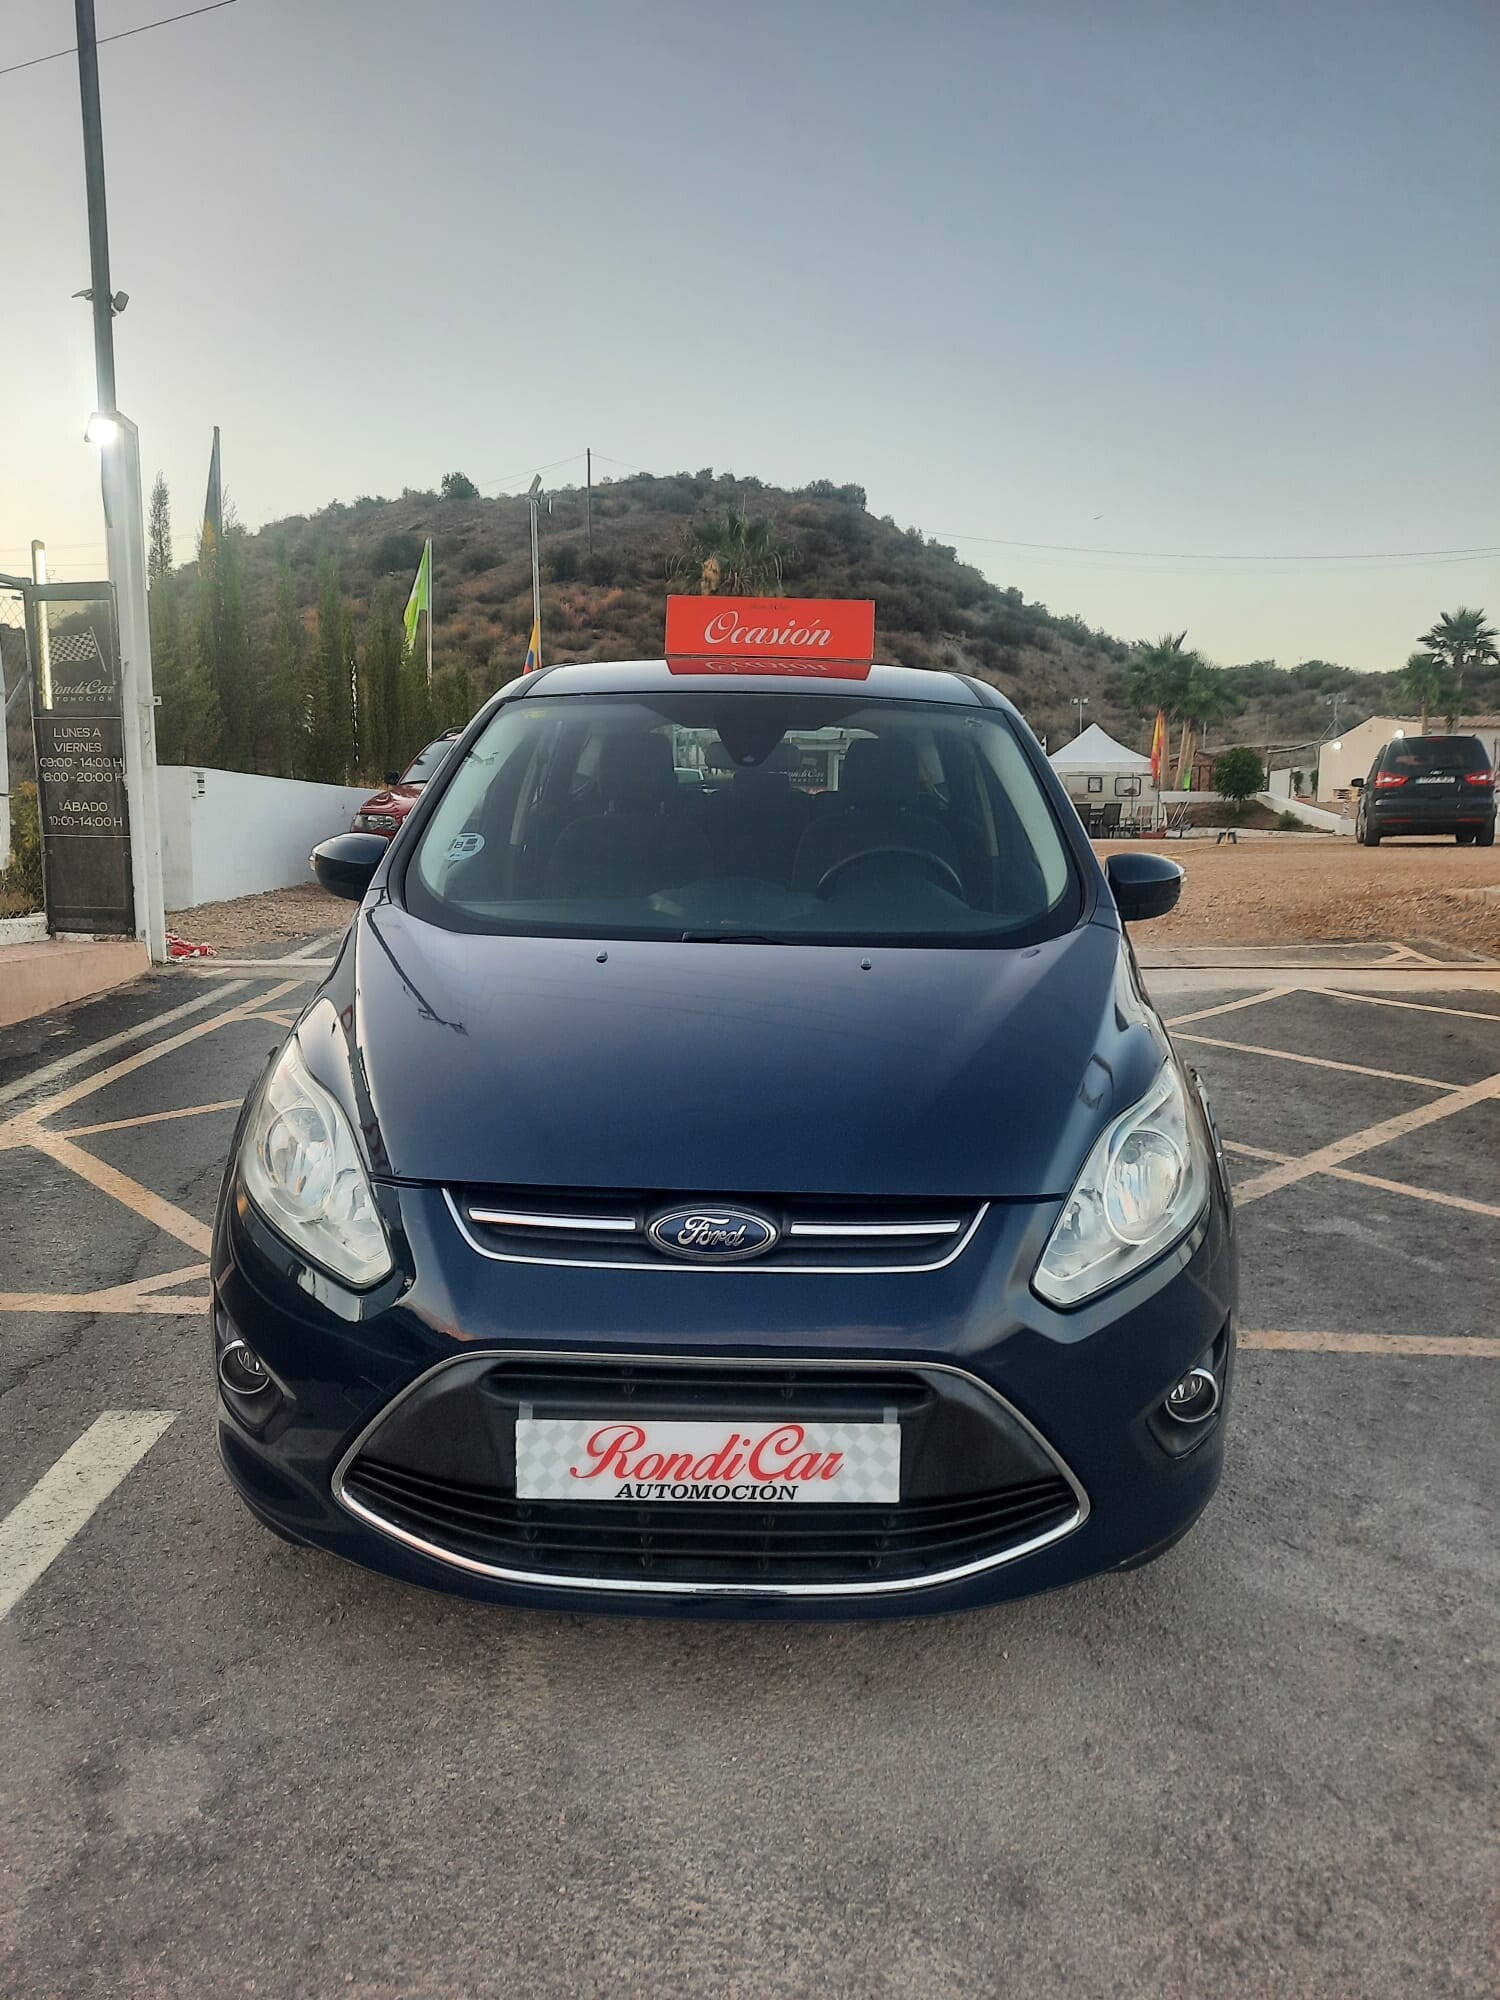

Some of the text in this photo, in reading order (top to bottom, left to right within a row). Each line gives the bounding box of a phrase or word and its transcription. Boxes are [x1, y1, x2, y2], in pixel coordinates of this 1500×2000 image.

[704, 610, 833, 646] Ocasión
[53, 727, 102, 738] LUNES A
[53, 742, 102, 753] VIERNES
[113, 816, 123, 827] H
[677, 1216, 747, 1247] Ford
[569, 1424, 844, 1482] RondiCar
[615, 1481, 799, 1501] AUTOMOCIÓN
